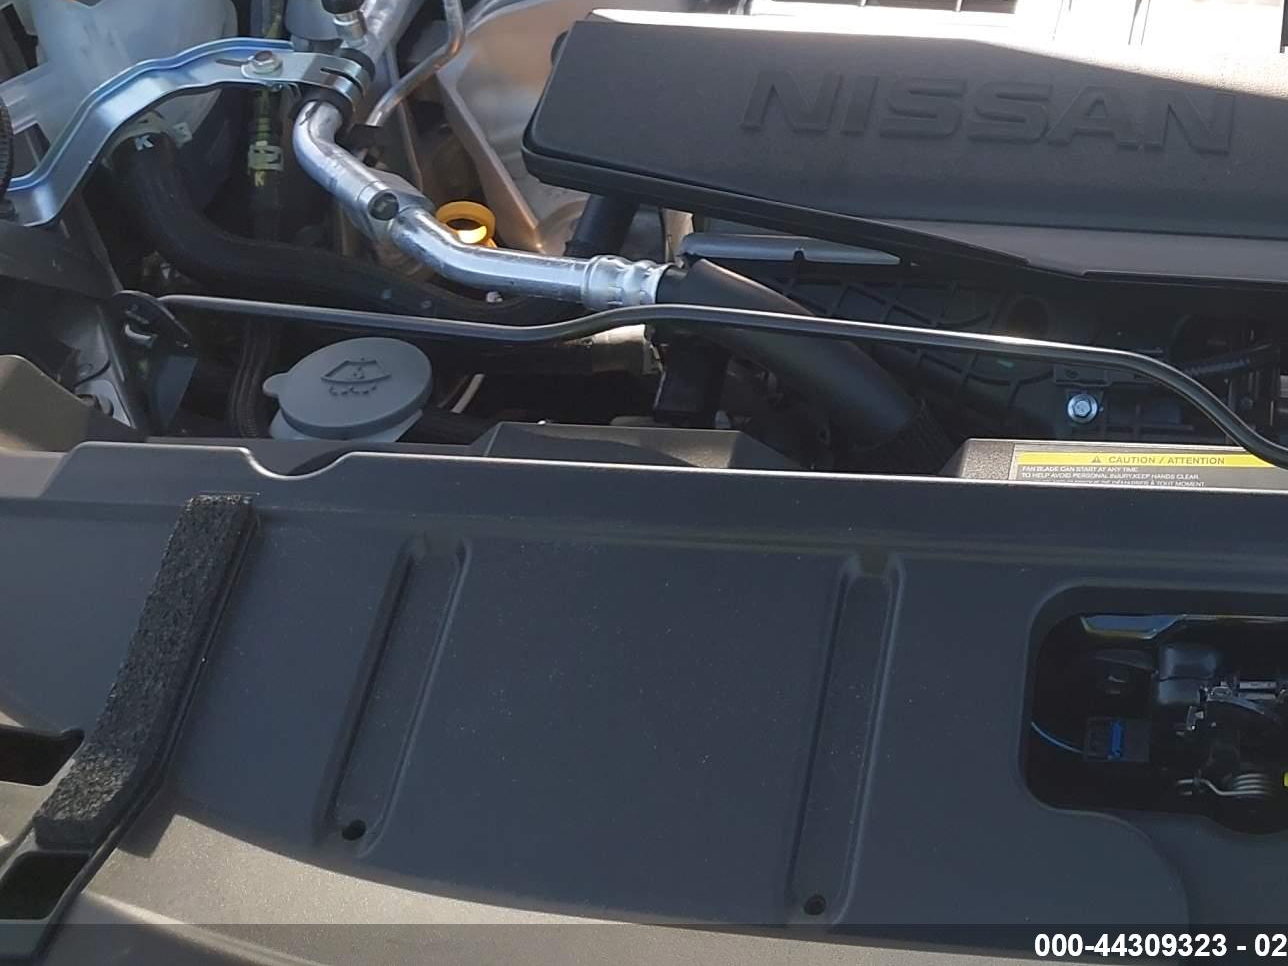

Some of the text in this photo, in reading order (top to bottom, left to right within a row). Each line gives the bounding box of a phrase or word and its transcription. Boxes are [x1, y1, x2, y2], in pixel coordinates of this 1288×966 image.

[738, 69, 1236, 156] NISSAN
[1108, 456, 1156, 465] CAUTION
[1168, 457, 1225, 465] ATTENTION
